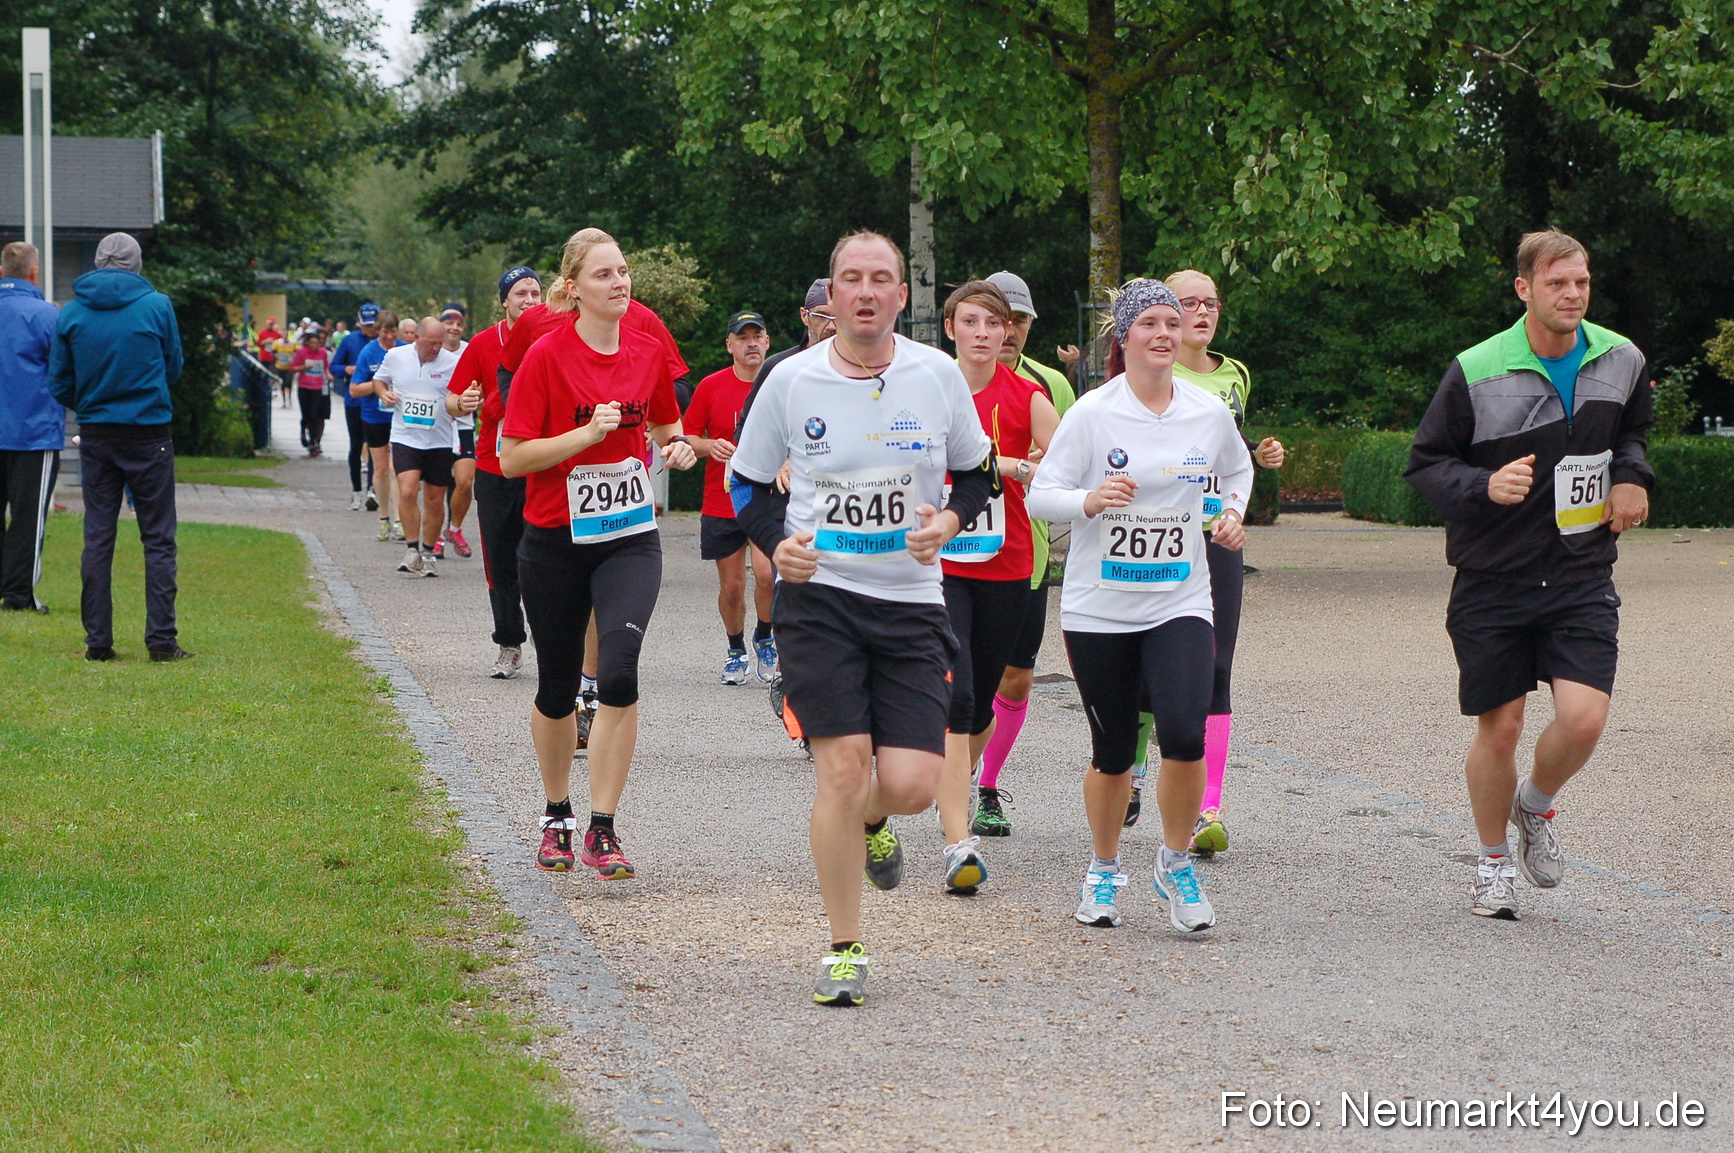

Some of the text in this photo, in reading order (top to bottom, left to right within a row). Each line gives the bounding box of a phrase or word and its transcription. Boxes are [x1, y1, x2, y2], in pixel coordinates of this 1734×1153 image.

[405, 402, 434, 417] 2591
[806, 442, 831, 451] PARTL
[568, 467, 634, 482] PARTL Neumarkt
[815, 479, 898, 490] PARTL Neumarkt
[1571, 471, 1605, 506] 561
[578, 476, 646, 514] 2940
[825, 492, 905, 527] 2646
[602, 517, 629, 531] Petra
[1103, 514, 1179, 523] PARTL Neumarkt
[836, 536, 895, 555] Siegfried
[943, 541, 981, 552] Nadine
[1110, 527, 1184, 560] 2673
[1112, 566, 1180, 582] Margaretha
